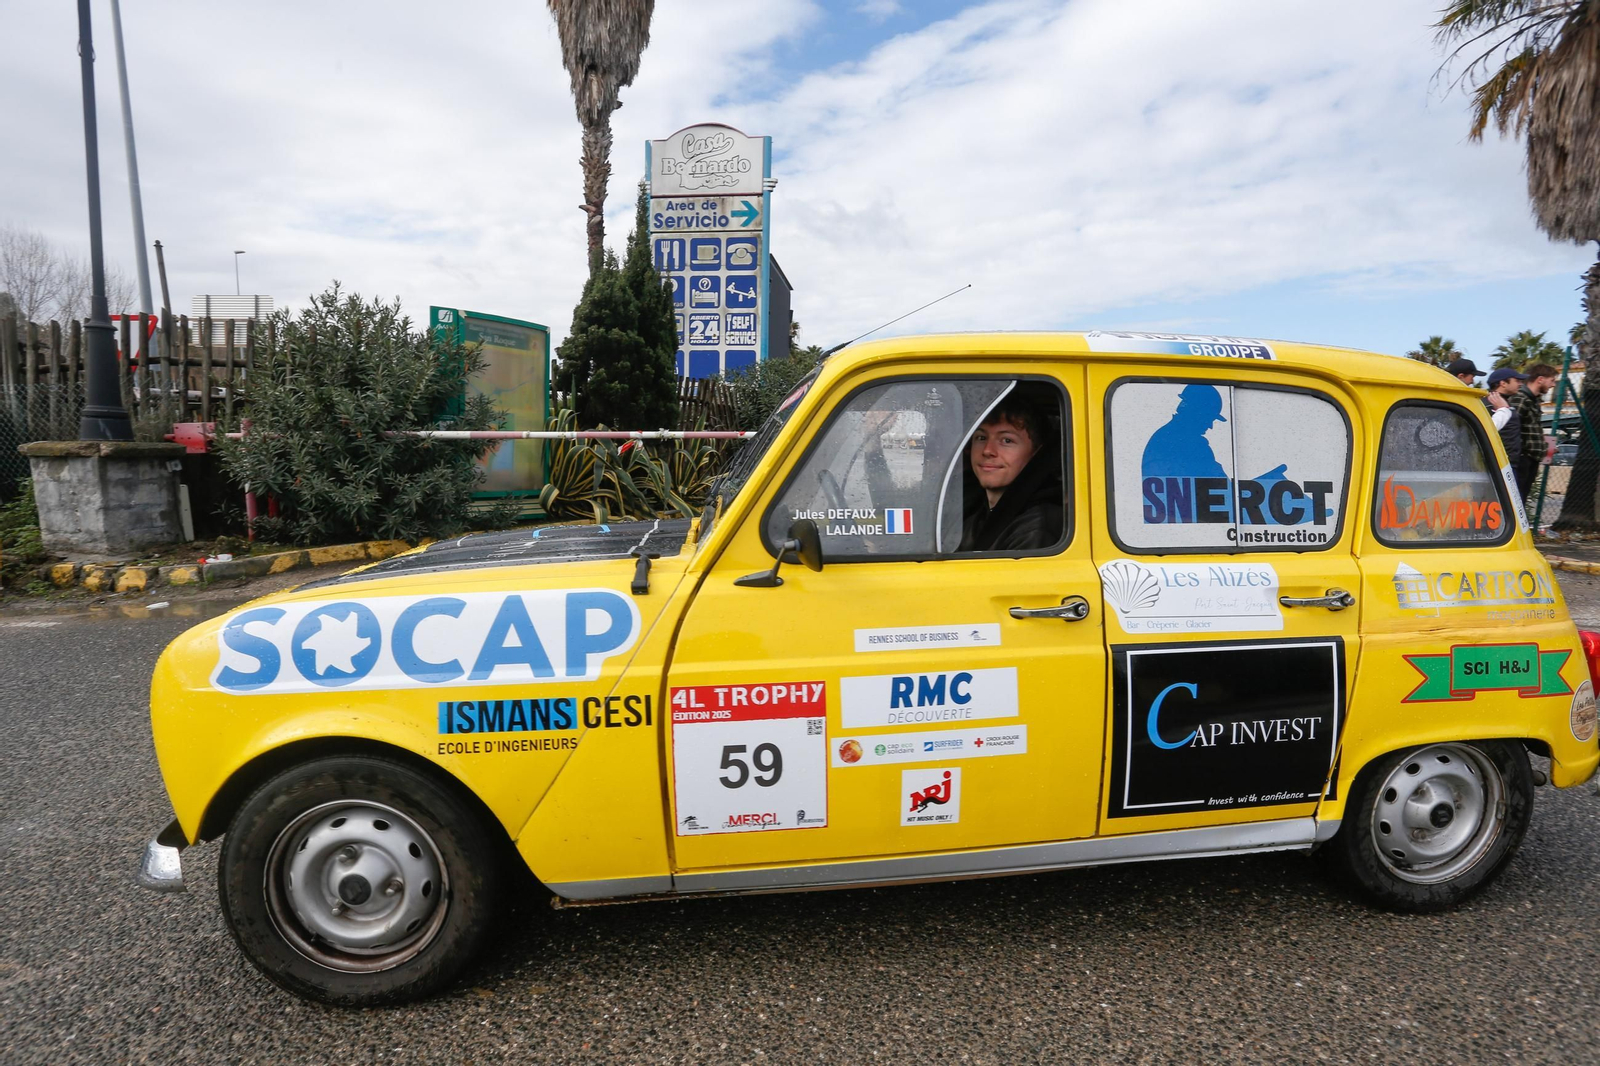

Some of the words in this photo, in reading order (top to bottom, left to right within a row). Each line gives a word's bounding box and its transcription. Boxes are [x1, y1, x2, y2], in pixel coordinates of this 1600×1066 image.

[682, 132, 734, 159] Casa
[661, 154, 751, 176] Bernardo
[665, 200, 695, 211] Area
[701, 200, 718, 210] de
[653, 212, 730, 229] Servicio
[690, 320, 720, 340] 24
[732, 315, 750, 329] SELF
[478, 332, 493, 343] San
[493, 335, 517, 347] Roque
[725, 331, 756, 345] SERVICE
[1188, 343, 1264, 360] GROUPE
[1142, 476, 1334, 526] SNERCT
[792, 509, 825, 520] Jules
[828, 508, 877, 519] DEFAUX
[826, 524, 883, 536] LALANDE
[1160, 566, 1200, 588] Les
[1208, 565, 1272, 587] Alizés
[1436, 570, 1554, 600] CARTRON
[1126, 620, 1140, 629] Bar
[1185, 619, 1212, 628] Glacier
[215, 591, 633, 692] SOCAP
[868, 634, 894, 644] RENNES
[894, 633, 919, 643] SCHOOL
[920, 633, 928, 642] OF
[929, 632, 959, 642] BUSINESS
[1463, 661, 1489, 675] SCI
[1499, 660, 1530, 674] H&J
[672, 689, 705, 709] 4L
[714, 683, 825, 707] TROPHY
[890, 672, 973, 709] RMC
[446, 697, 572, 734] ISMANS
[583, 694, 653, 729] CESI
[711, 710, 732, 719] 2025
[887, 707, 973, 724] DÉCOUVERTE
[1230, 717, 1322, 746] INVEST
[438, 741, 480, 755] ECOLE
[485, 737, 578, 754] D'INGENIEURS
[934, 739, 963, 748] SURFRIDER
[719, 742, 783, 789] 59
[1207, 796, 1234, 806] Invest
[1237, 793, 1258, 804] with
[1260, 790, 1305, 802] confidence
[729, 812, 777, 825] MERCI
